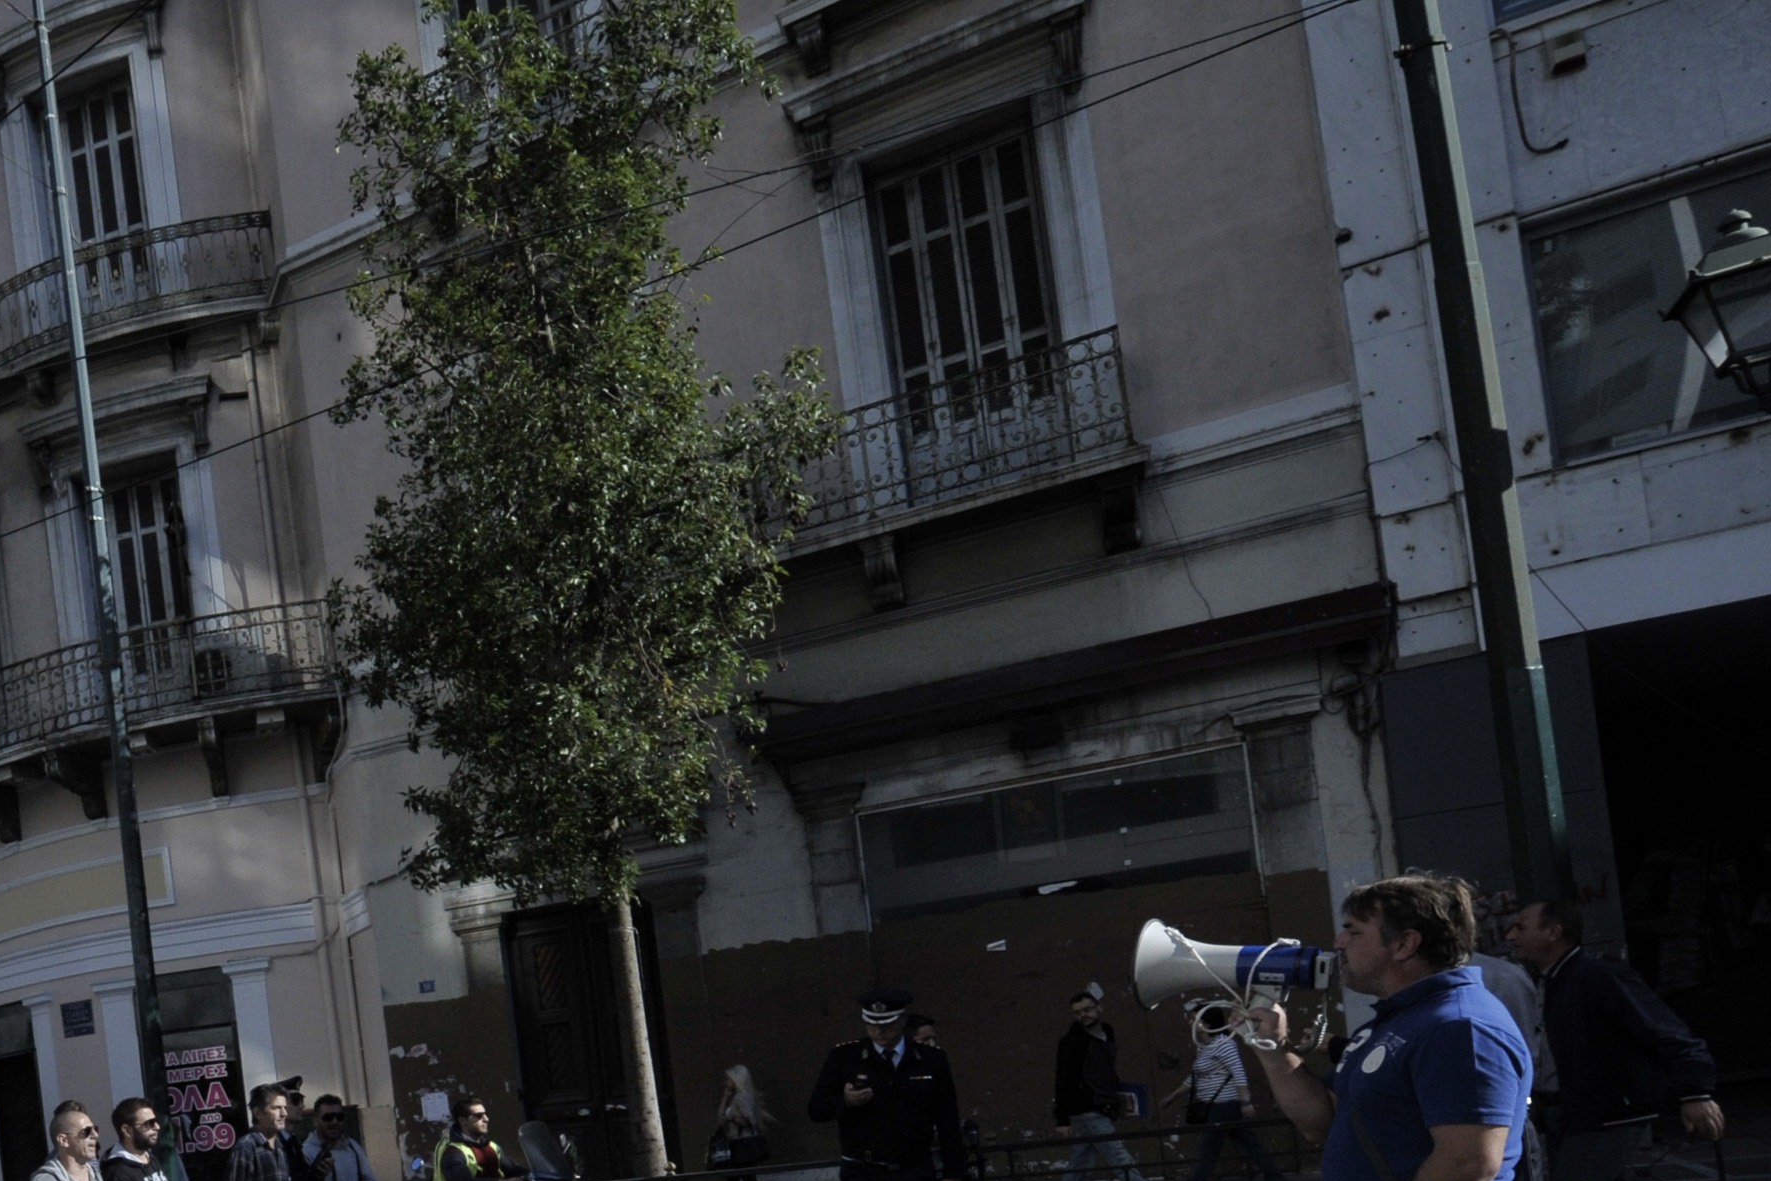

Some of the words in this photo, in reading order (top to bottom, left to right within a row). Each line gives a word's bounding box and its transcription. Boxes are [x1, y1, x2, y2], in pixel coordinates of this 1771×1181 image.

[181, 1046, 227, 1064] ΛΙΓΕΣ
[166, 1063, 228, 1083] ΜΕΡΕΣ
[200, 1113, 222, 1124] ΑΠΟ
